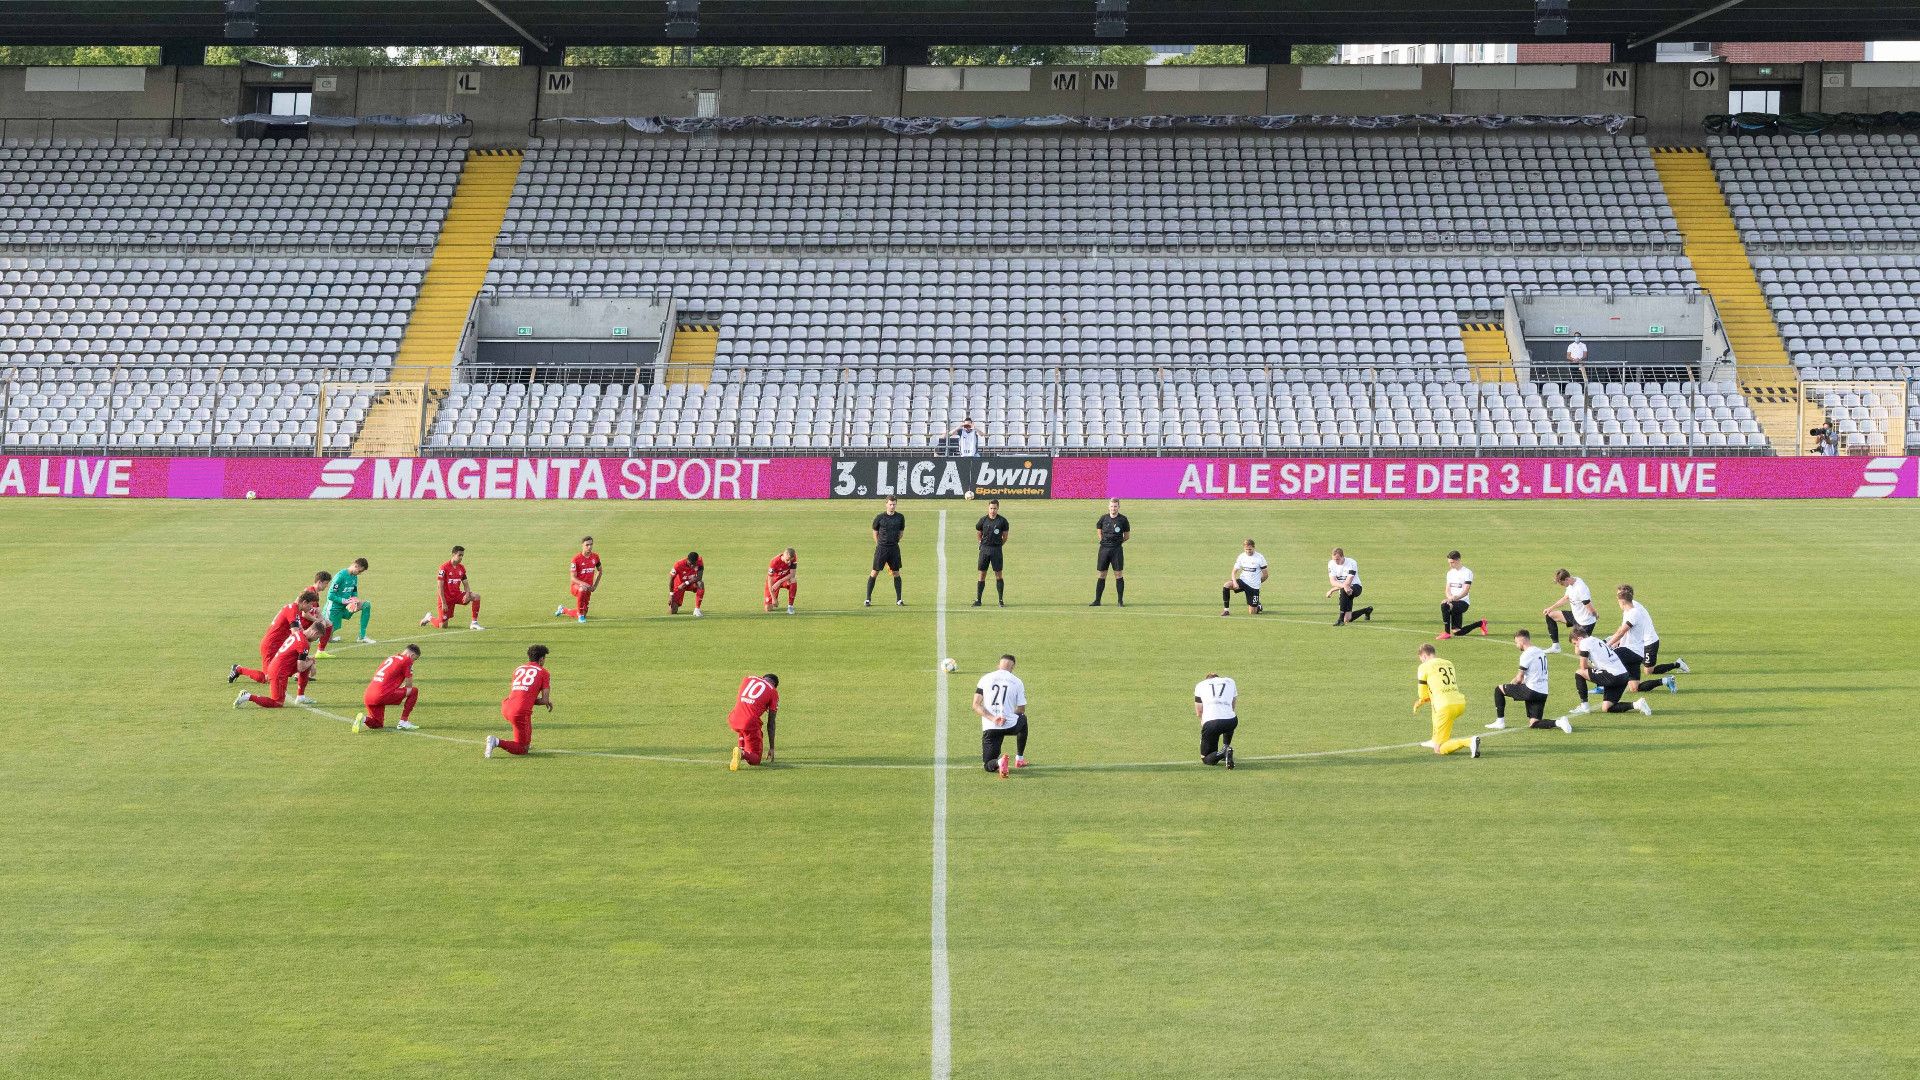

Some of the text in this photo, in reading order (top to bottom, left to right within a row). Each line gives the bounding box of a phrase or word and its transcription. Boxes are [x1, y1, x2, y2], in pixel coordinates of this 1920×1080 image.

[465, 74, 476, 90] L
[548, 74, 566, 90] M
[1059, 74, 1076, 89] M
[1094, 74, 1109, 89] N
[1612, 71, 1626, 87] N
[1693, 70, 1709, 87] O
[38, 458, 132, 495] LIVE
[372, 458, 771, 499] MAGENTA SPORT
[834, 460, 964, 495] 3. LIGA
[975, 460, 1048, 485] bwin
[1177, 463, 1717, 495] ALLE SPIELE DER 3. LIGA LIVE
[975, 487, 1045, 496] Sportwetten
[376, 657, 394, 676] 2
[513, 668, 538, 686] 28
[1438, 667, 1456, 685] 35
[741, 679, 767, 699] 10
[991, 684, 1008, 706] 21
[1208, 683, 1226, 698] 17
